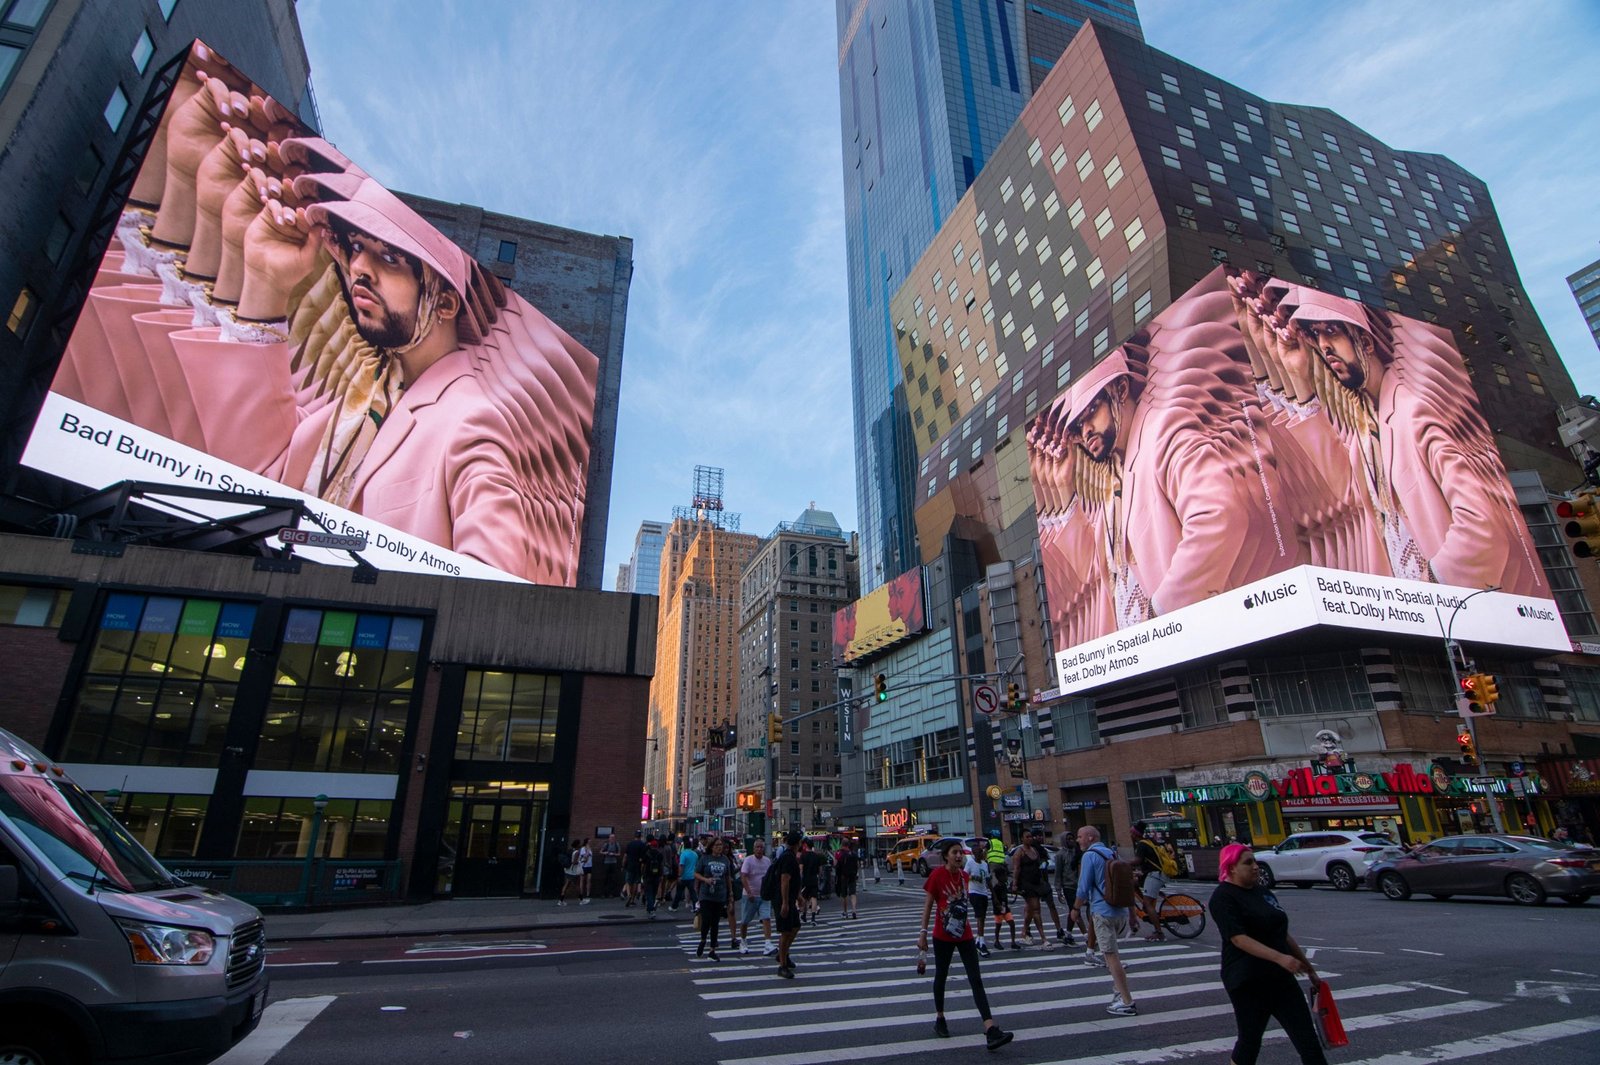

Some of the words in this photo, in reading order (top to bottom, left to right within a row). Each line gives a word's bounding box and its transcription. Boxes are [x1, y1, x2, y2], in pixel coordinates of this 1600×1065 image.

[59, 412, 112, 447] Bad
[116, 434, 191, 478] Bunny
[194, 464, 213, 485] in
[376, 533, 417, 562] Dolby
[419, 550, 461, 576] Atmos
[282, 531, 305, 542] BIG
[310, 535, 362, 547] OUTDOOR
[1253, 583, 1298, 607] Music
[1317, 577, 1342, 594] Bad
[1343, 581, 1381, 602] Bunny
[1384, 585, 1393, 600] in
[1397, 588, 1434, 606] Spatial
[1436, 594, 1467, 609] Audio
[1323, 599, 1350, 615] feat.
[1352, 602, 1384, 621] Dolby
[1388, 606, 1425, 623] Atmos
[1525, 606, 1554, 621] Music
[1062, 653, 1078, 670] Bad
[1079, 647, 1106, 665] Bunny
[1107, 644, 1116, 655] in
[1117, 633, 1150, 653] Spatial
[1152, 621, 1183, 640] Audio
[1064, 671, 1081, 684] feat.
[1082, 663, 1107, 681] Dolby
[1109, 653, 1139, 672] Atmos
[840, 688, 851, 741] WSTIN
[1270, 767, 1338, 798] villa
[1382, 764, 1434, 794] villa
[1161, 790, 1186, 803] PIZZA
[1197, 787, 1231, 801] SALADS
[1338, 795, 1389, 804] CHEESESTEAKS
[174, 868, 212, 880] Subway
